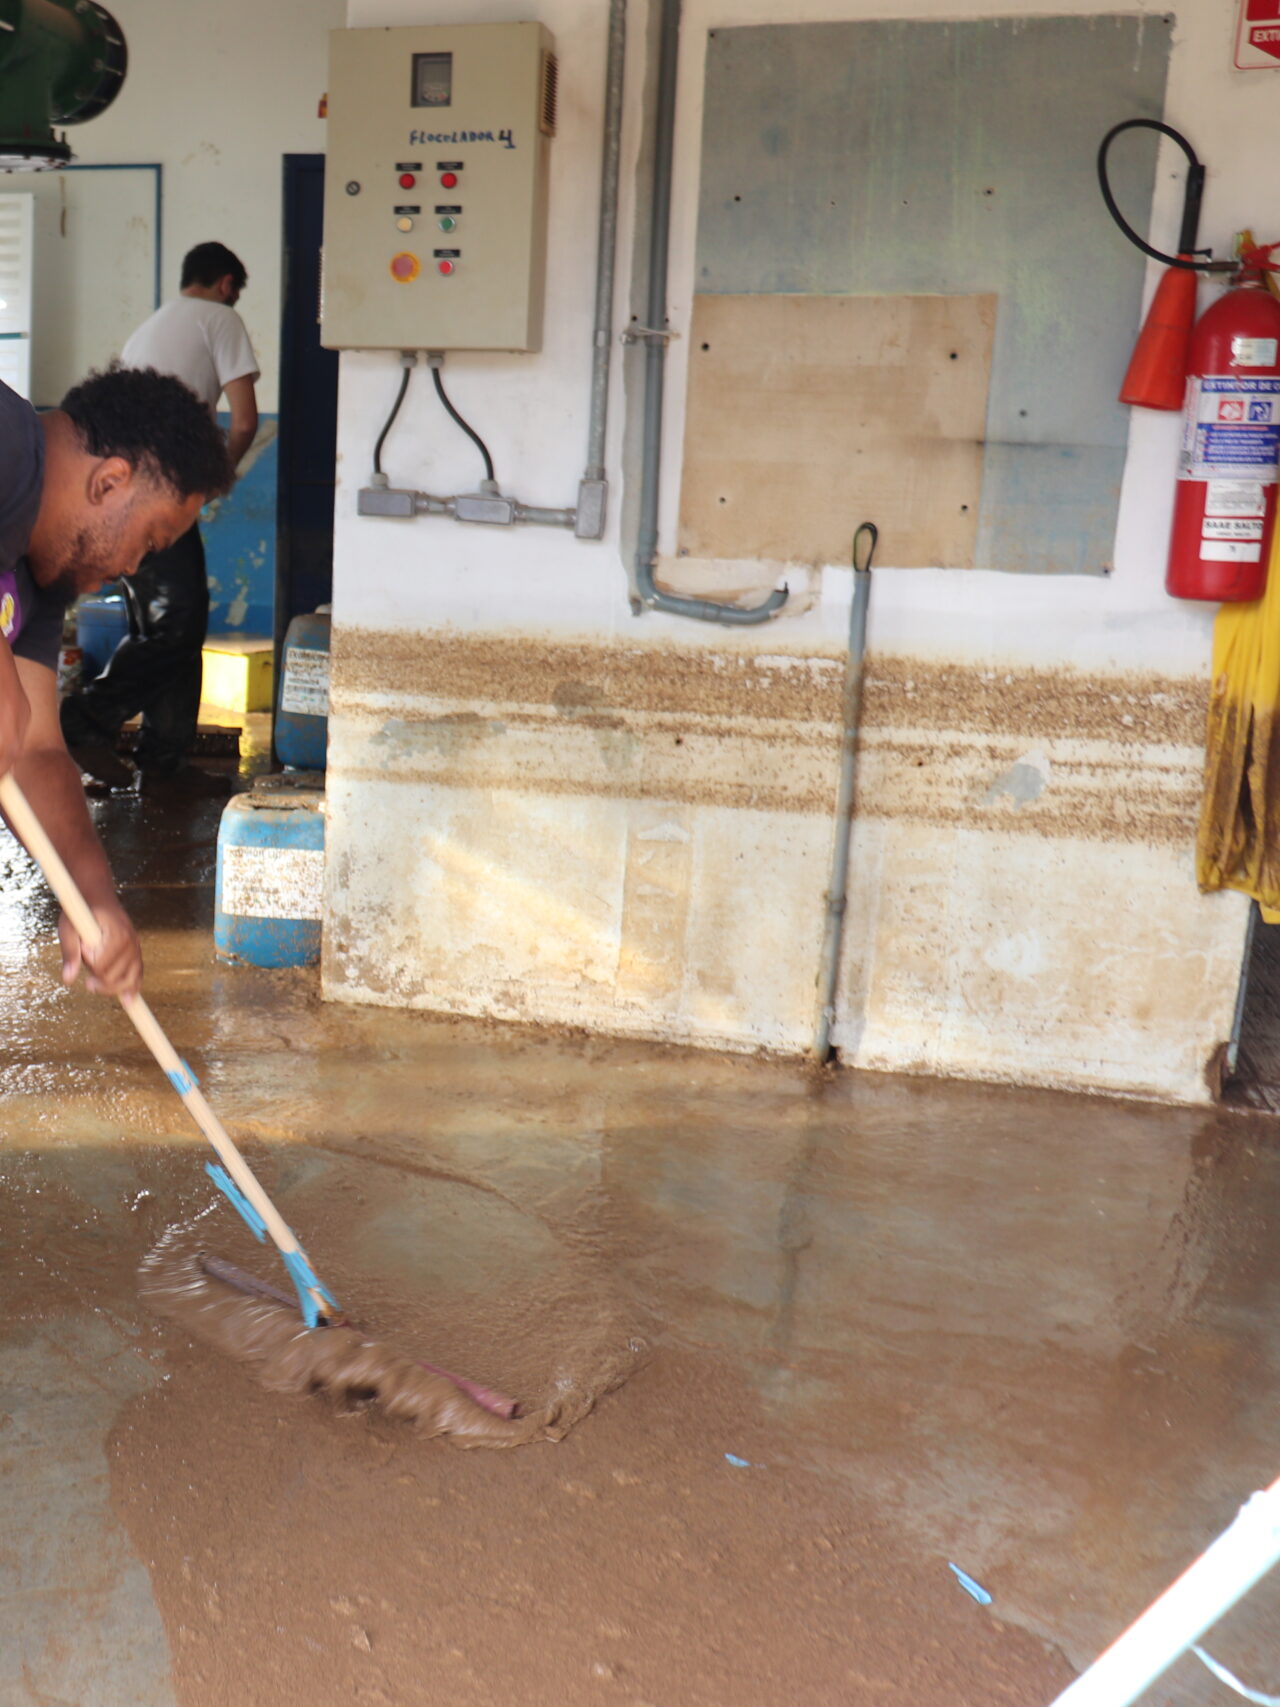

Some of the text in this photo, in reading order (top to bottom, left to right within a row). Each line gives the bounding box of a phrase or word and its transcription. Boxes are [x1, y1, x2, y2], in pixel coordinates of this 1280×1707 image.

[409, 129, 516, 149] FLOCULADOR 4
[1205, 521, 1264, 531] SAAE SALTO
